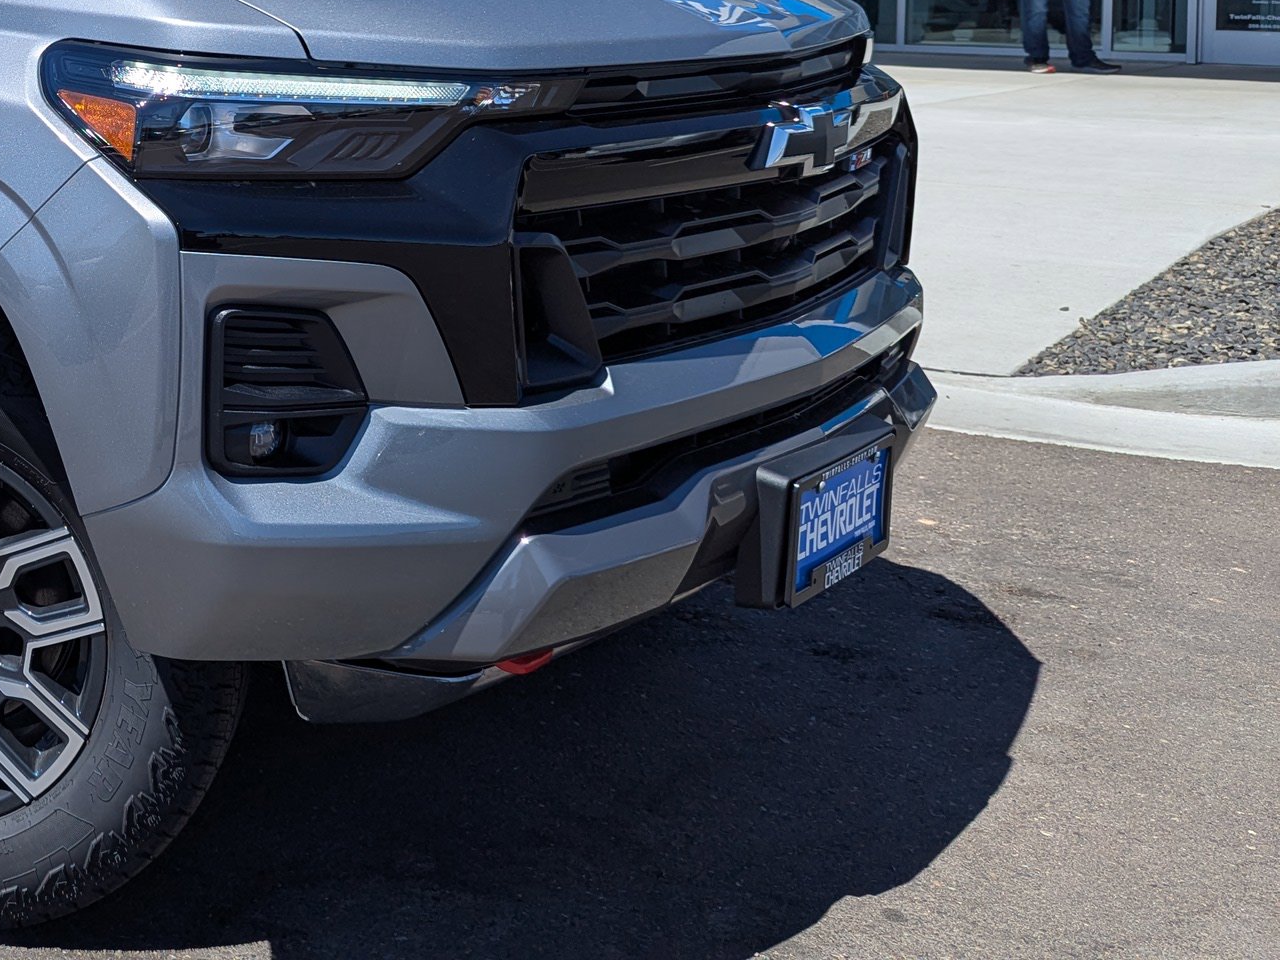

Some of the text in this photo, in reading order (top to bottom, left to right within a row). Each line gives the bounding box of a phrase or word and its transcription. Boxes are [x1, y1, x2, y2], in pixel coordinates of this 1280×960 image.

[800, 463, 882, 525] TWINFALLS
[797, 483, 880, 560] CHEVROLET
[824, 552, 864, 590] CHEVROLET
[825, 542, 865, 573] TWINFALLS
